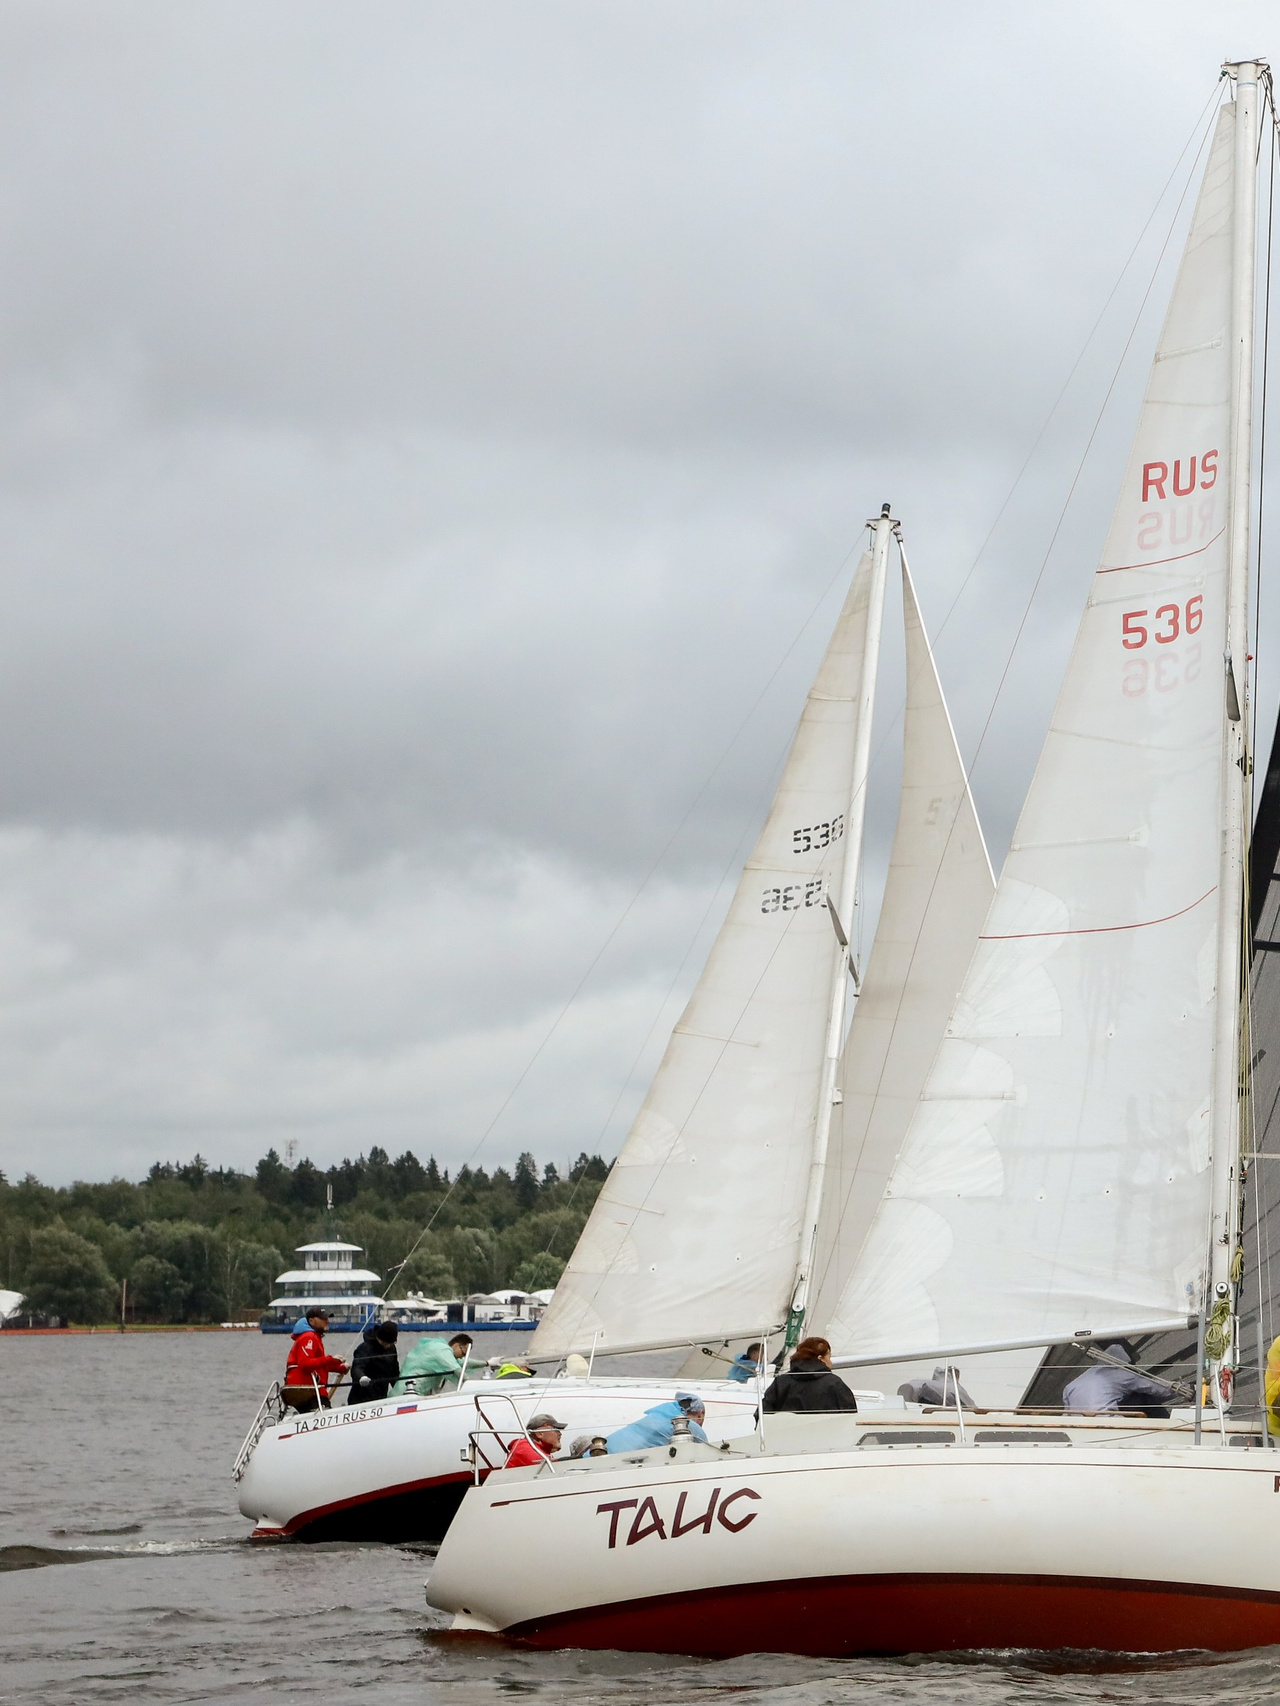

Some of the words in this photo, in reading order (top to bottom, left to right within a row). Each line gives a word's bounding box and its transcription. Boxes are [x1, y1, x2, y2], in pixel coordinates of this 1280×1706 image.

[1142, 449, 1219, 502] RUS
[1122, 594, 1203, 650] 536
[793, 815, 843, 854] 536
[294, 1422, 310, 1434] TA
[313, 1415, 339, 1430] 2071
[343, 1410, 366, 1423] RUS
[370, 1407, 383, 1418] 50
